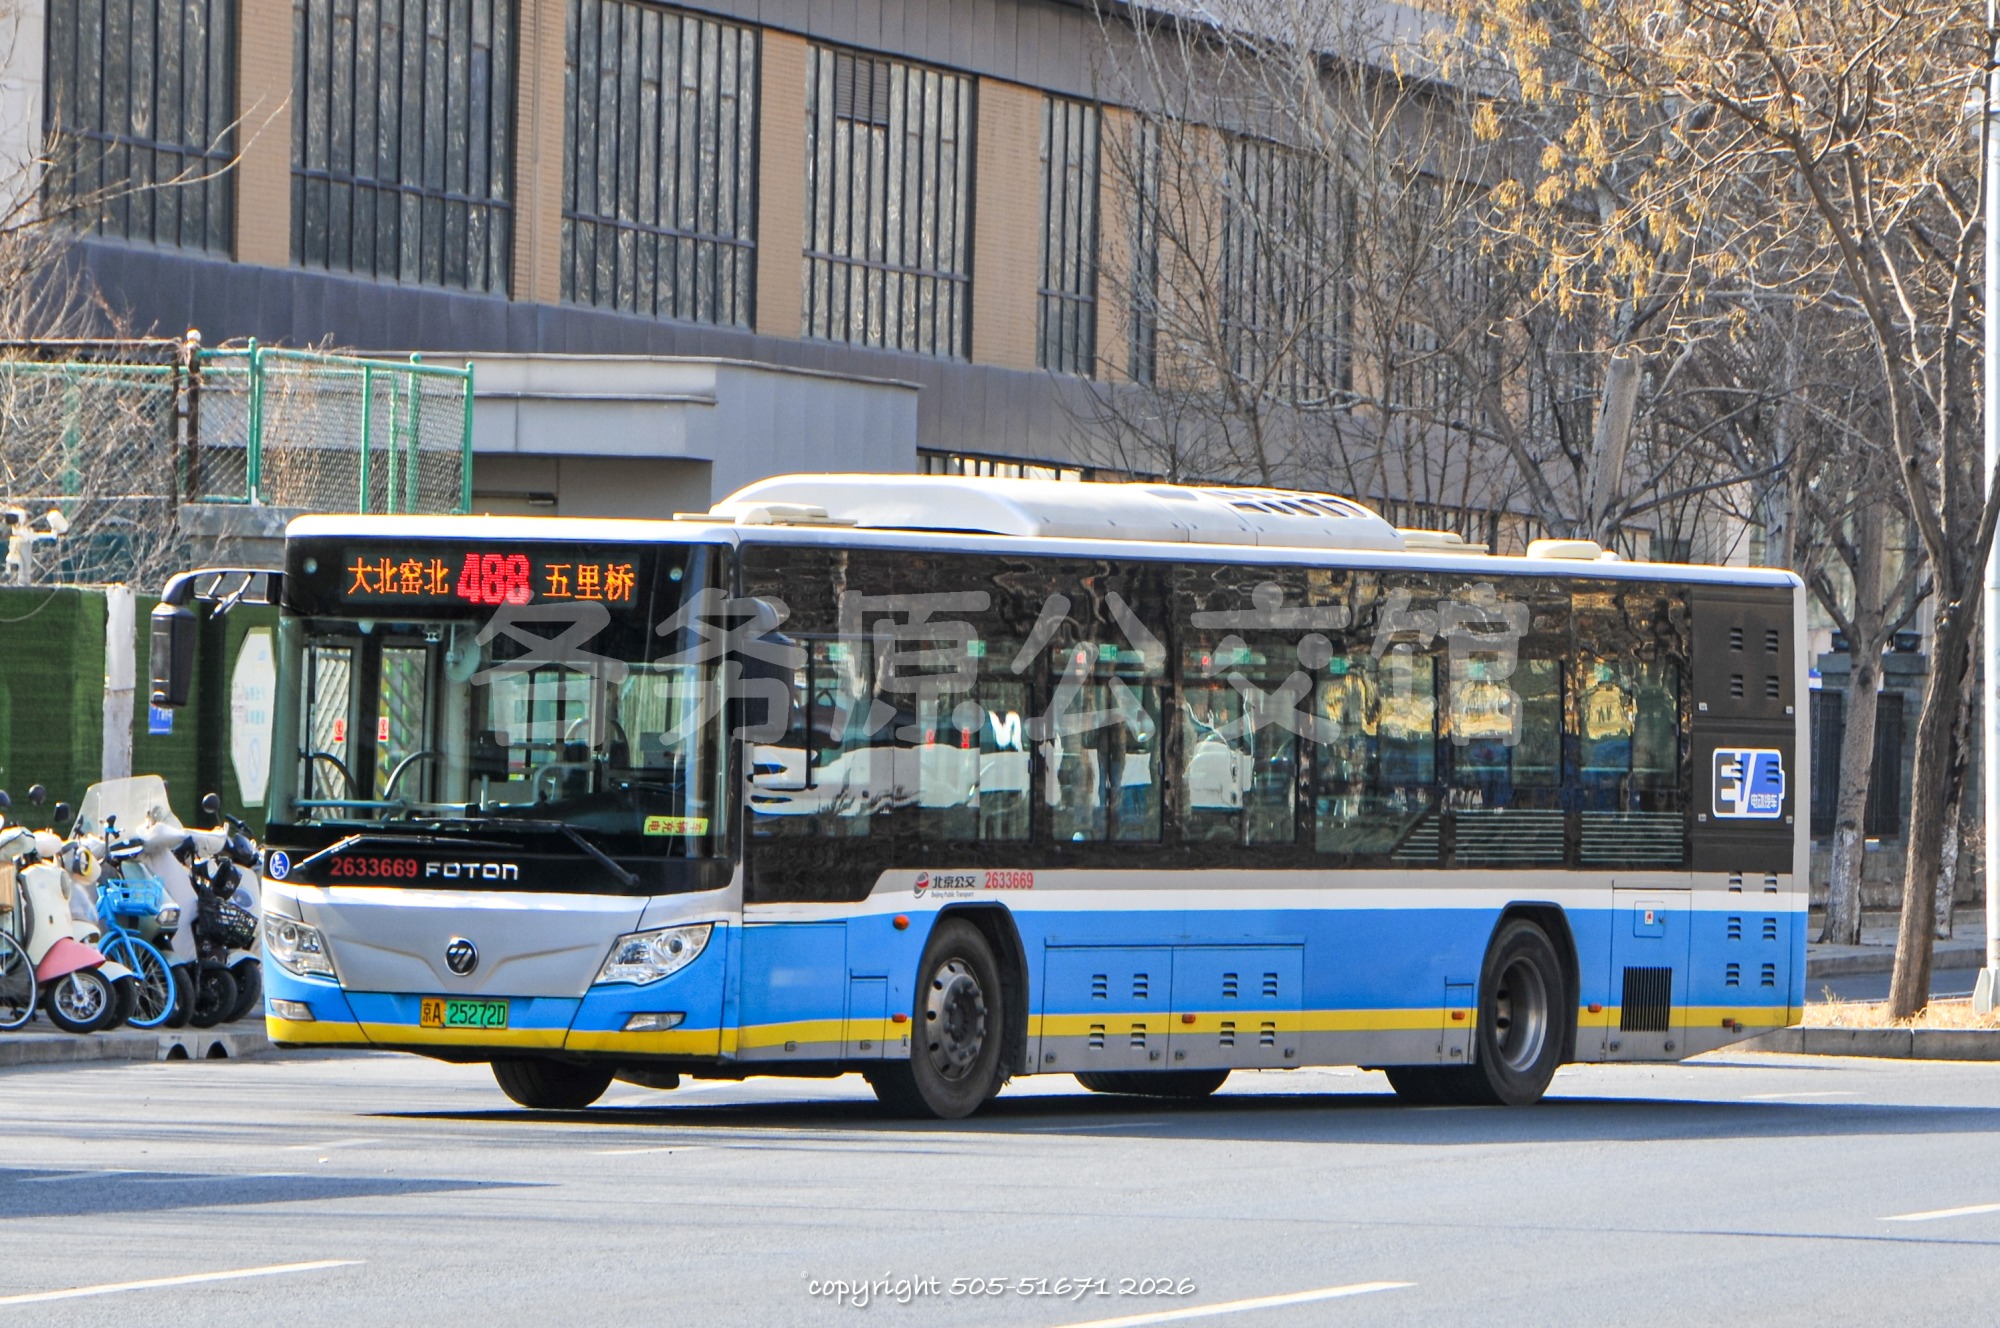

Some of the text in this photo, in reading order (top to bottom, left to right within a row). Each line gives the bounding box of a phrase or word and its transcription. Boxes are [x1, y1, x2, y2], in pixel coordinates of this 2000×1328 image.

[348, 553, 635, 604] 大北窑北 488 五里桥
[330, 857, 519, 881] 2633669 FOTON
[932, 876, 976, 889] 北京公交
[984, 871, 1034, 889] 2633669
